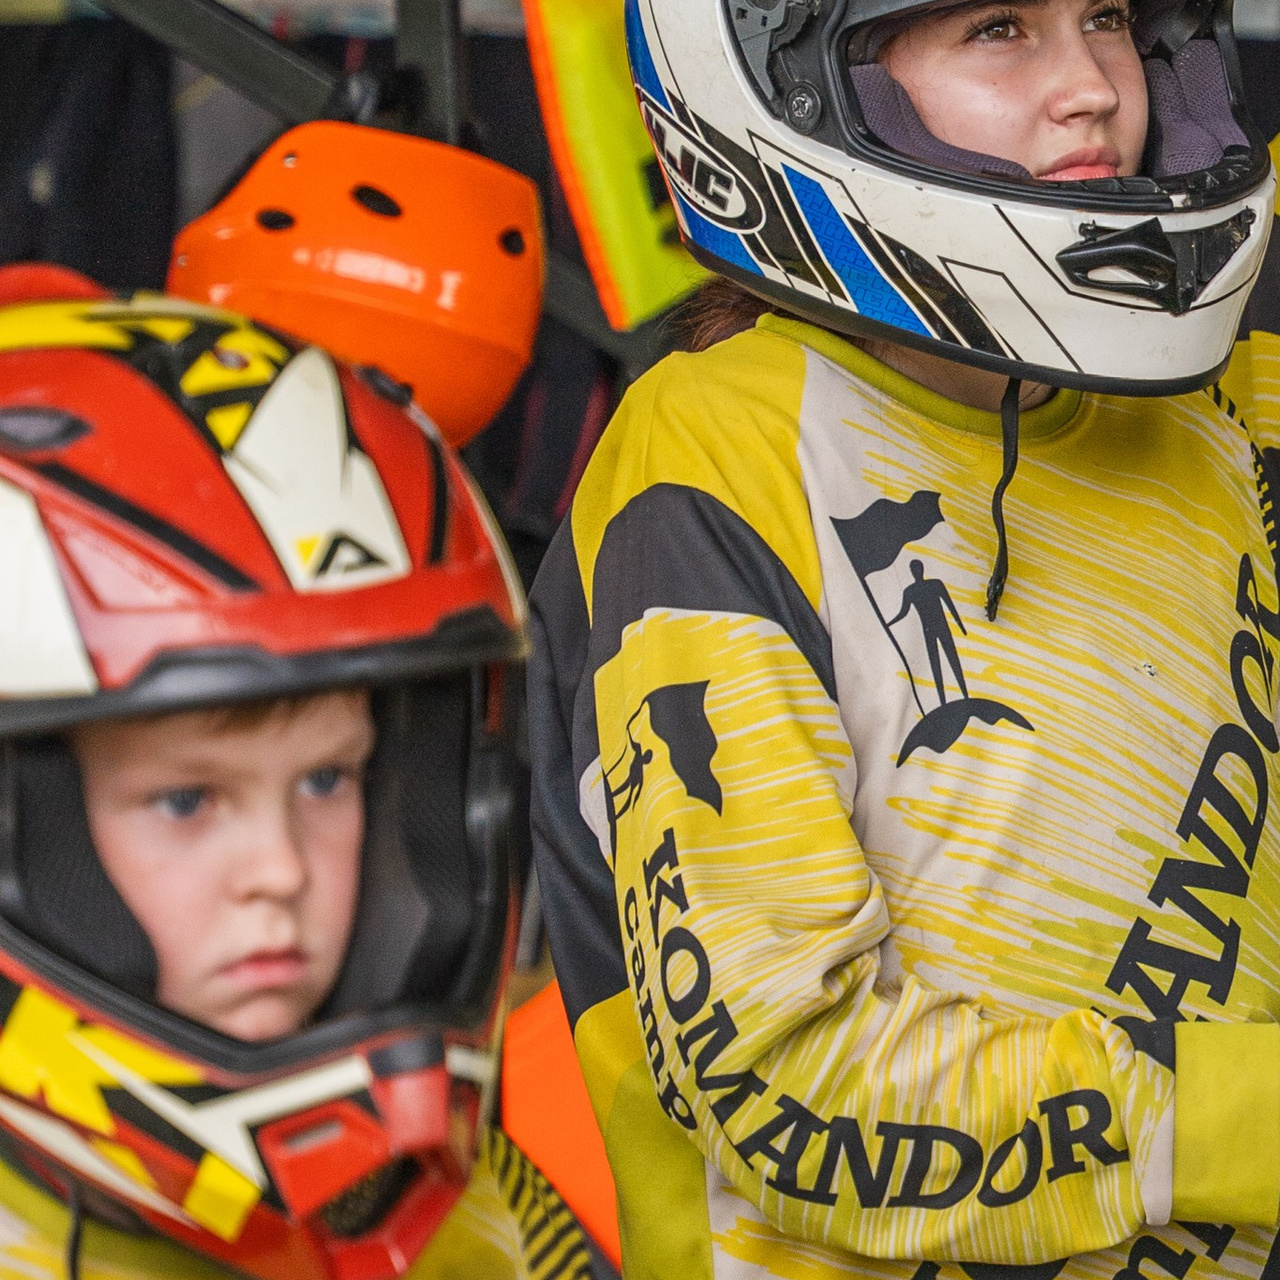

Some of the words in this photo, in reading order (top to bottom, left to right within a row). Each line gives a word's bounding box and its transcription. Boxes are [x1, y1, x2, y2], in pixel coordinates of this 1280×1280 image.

[644, 103, 735, 212] HJC
[623, 886, 698, 1131] camp
[641, 827, 1130, 1210] KOMANDOR
